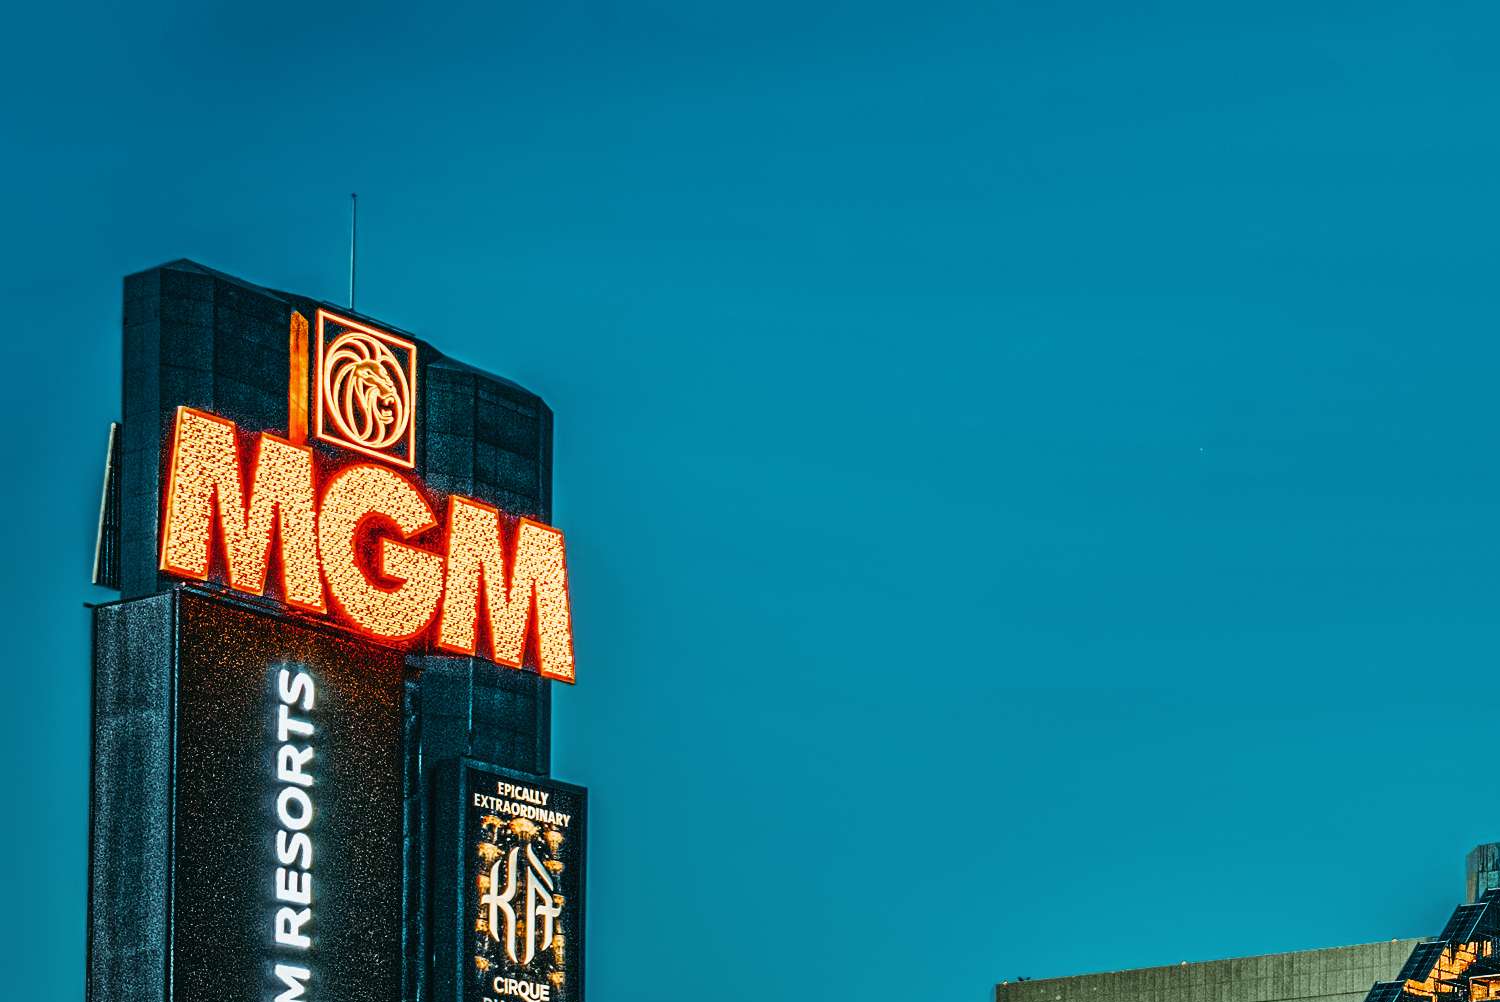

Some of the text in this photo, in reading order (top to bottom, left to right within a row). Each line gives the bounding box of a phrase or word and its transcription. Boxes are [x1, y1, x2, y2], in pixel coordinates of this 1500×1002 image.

[160, 406, 576, 684] MGM
[275, 669, 316, 949] RESORTS
[474, 792, 571, 828] EXTRAORDINARY
[497, 781, 549, 807] EPICALLY
